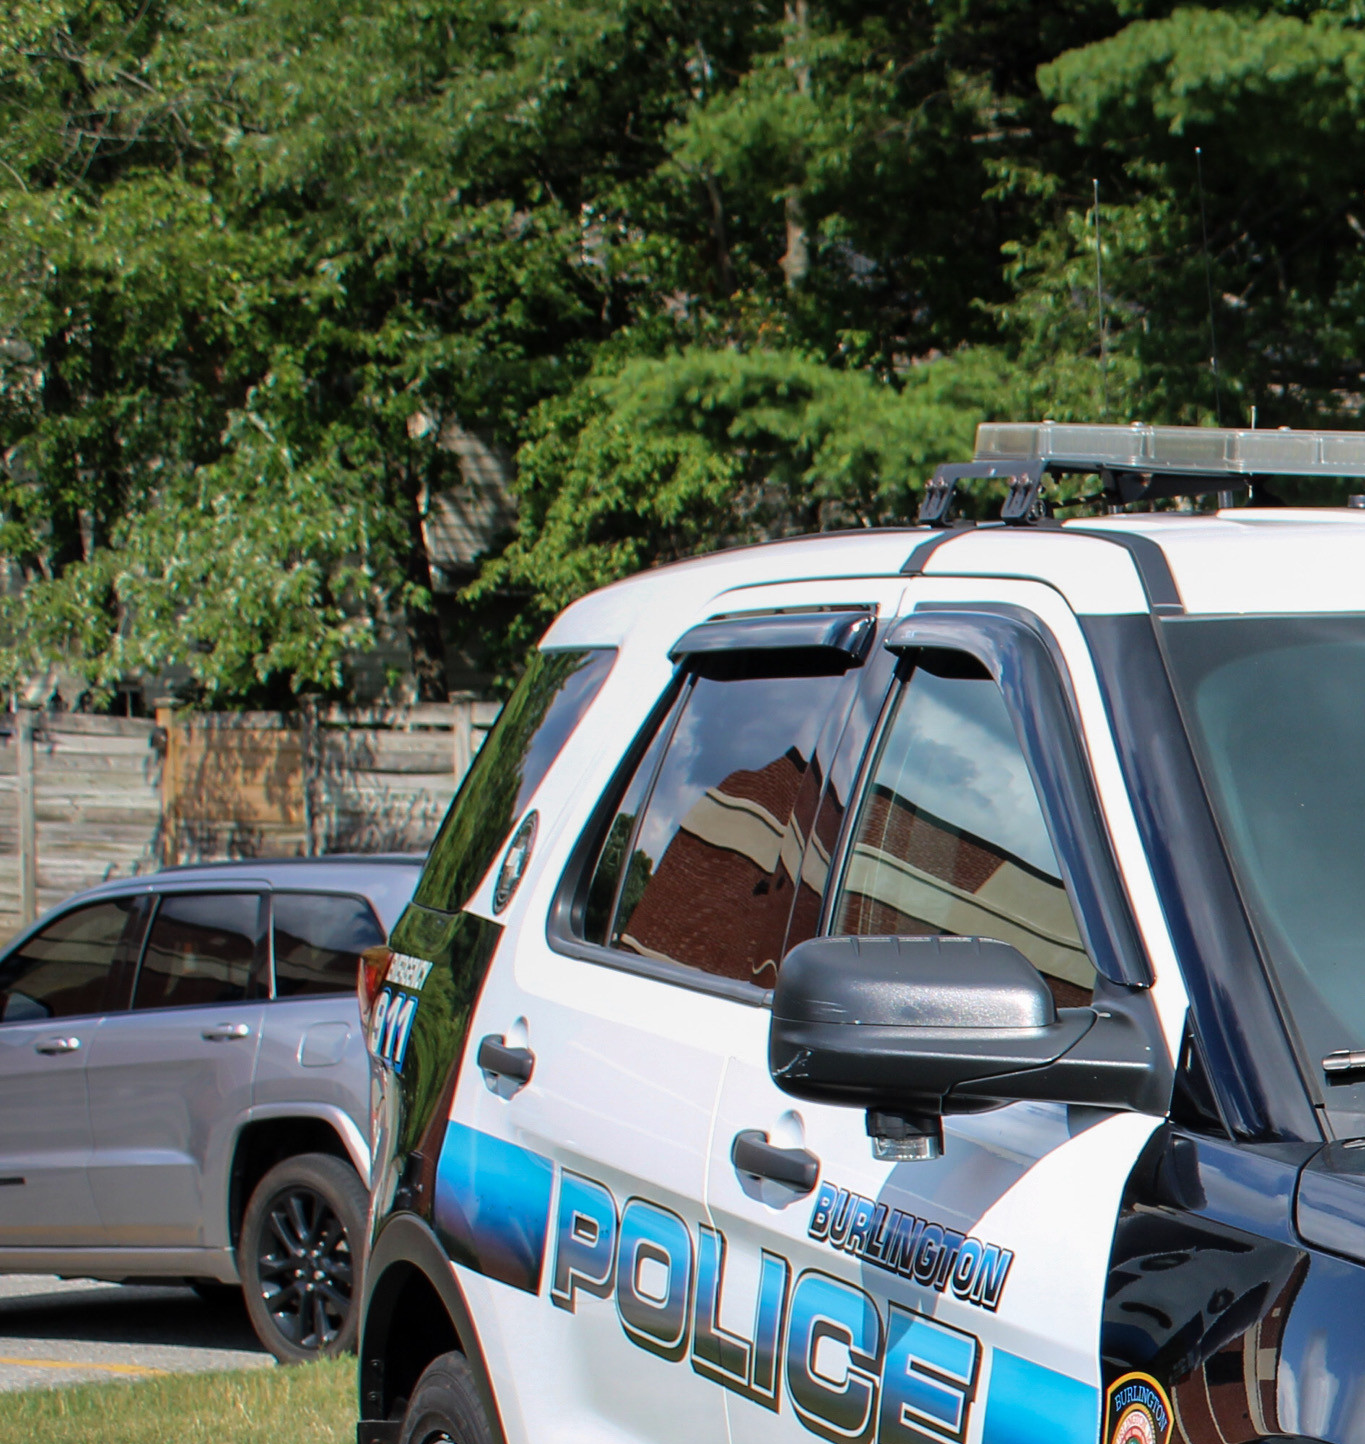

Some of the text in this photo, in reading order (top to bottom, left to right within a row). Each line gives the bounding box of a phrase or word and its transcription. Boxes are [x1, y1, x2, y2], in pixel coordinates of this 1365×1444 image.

[367, 986, 419, 1074] 911
[808, 1181, 1015, 1313] BURLINGTON
[1114, 1385, 1168, 1433] BURLINGTON
